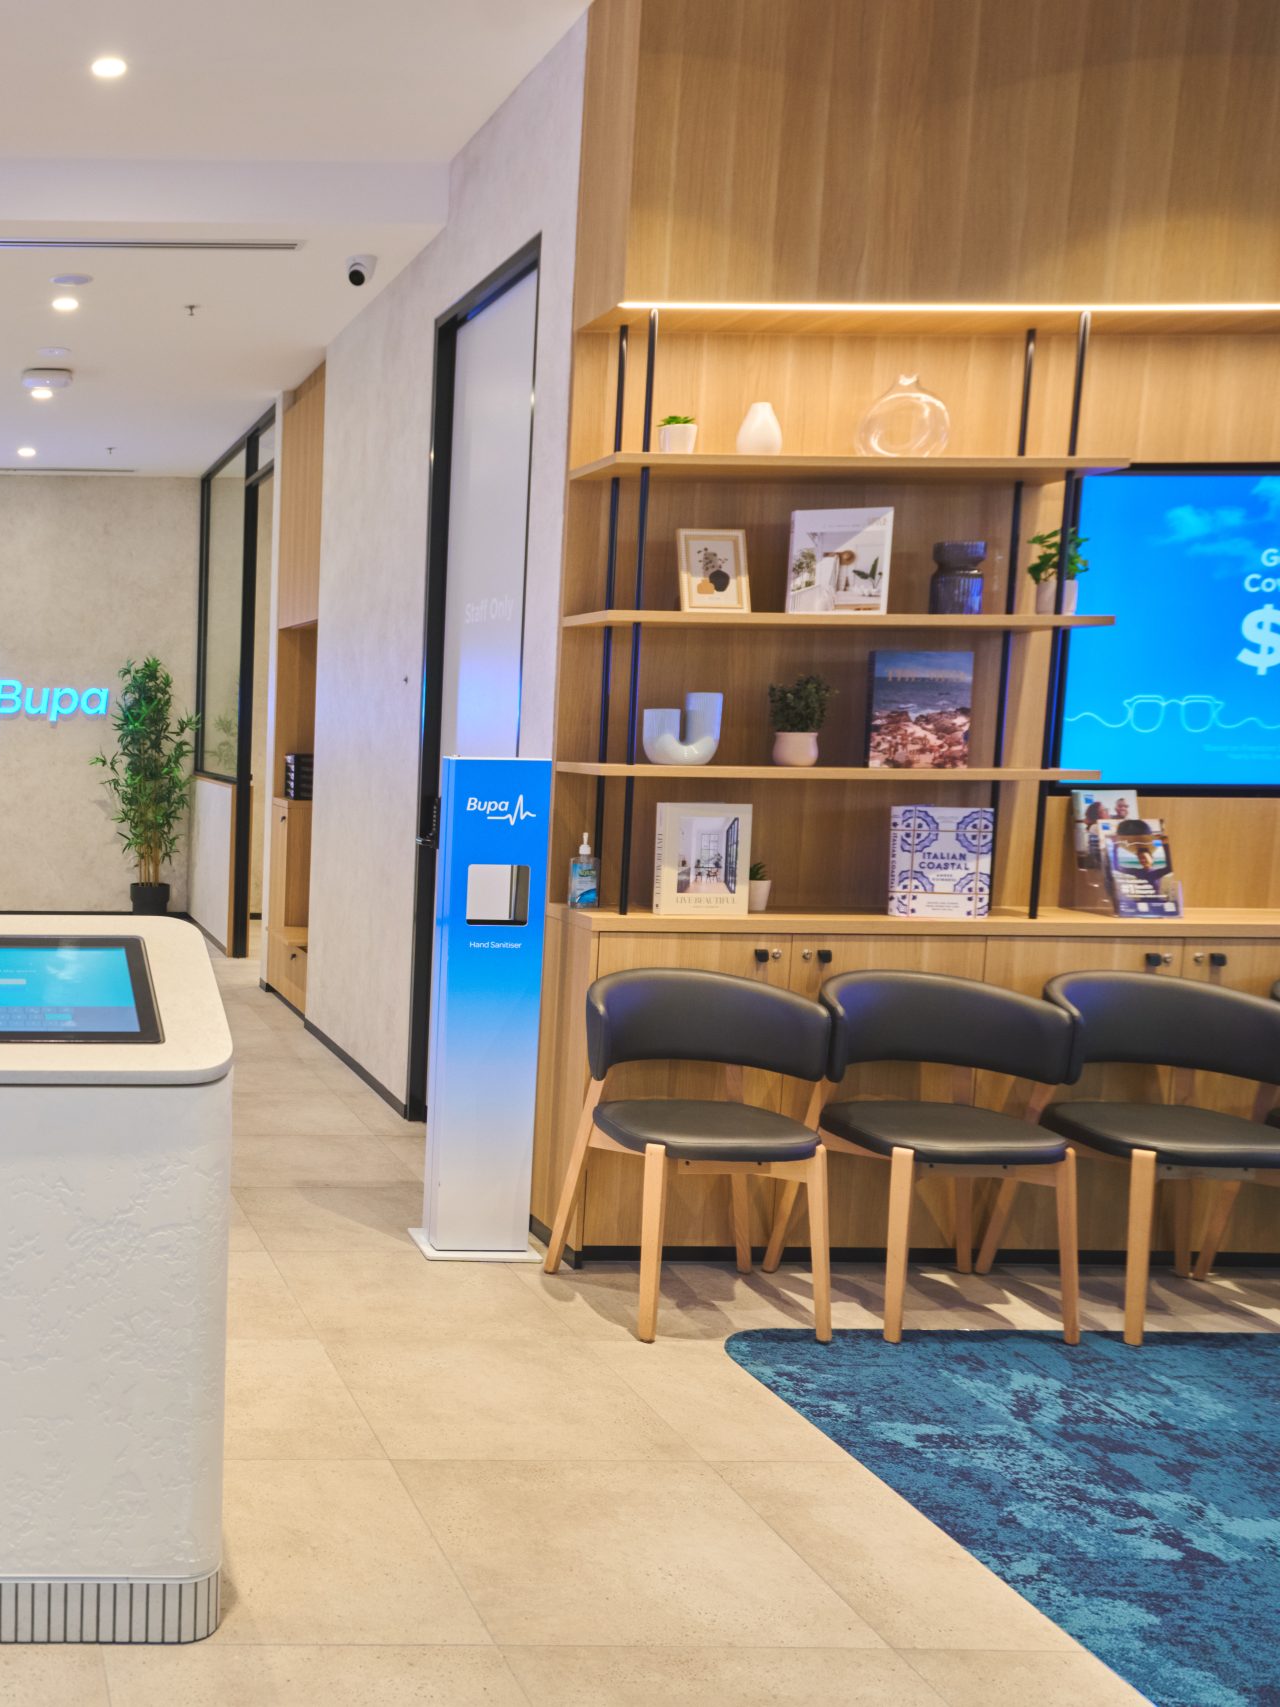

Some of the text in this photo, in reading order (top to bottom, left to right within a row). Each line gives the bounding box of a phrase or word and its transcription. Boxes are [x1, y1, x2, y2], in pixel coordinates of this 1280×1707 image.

[465, 594, 514, 624] Staff Only
[466, 797, 509, 814] Bupa
[922, 852, 967, 861] ITALIAN
[918, 861, 970, 871] COASTAL
[469, 941, 522, 949] Hand Sanitiser
